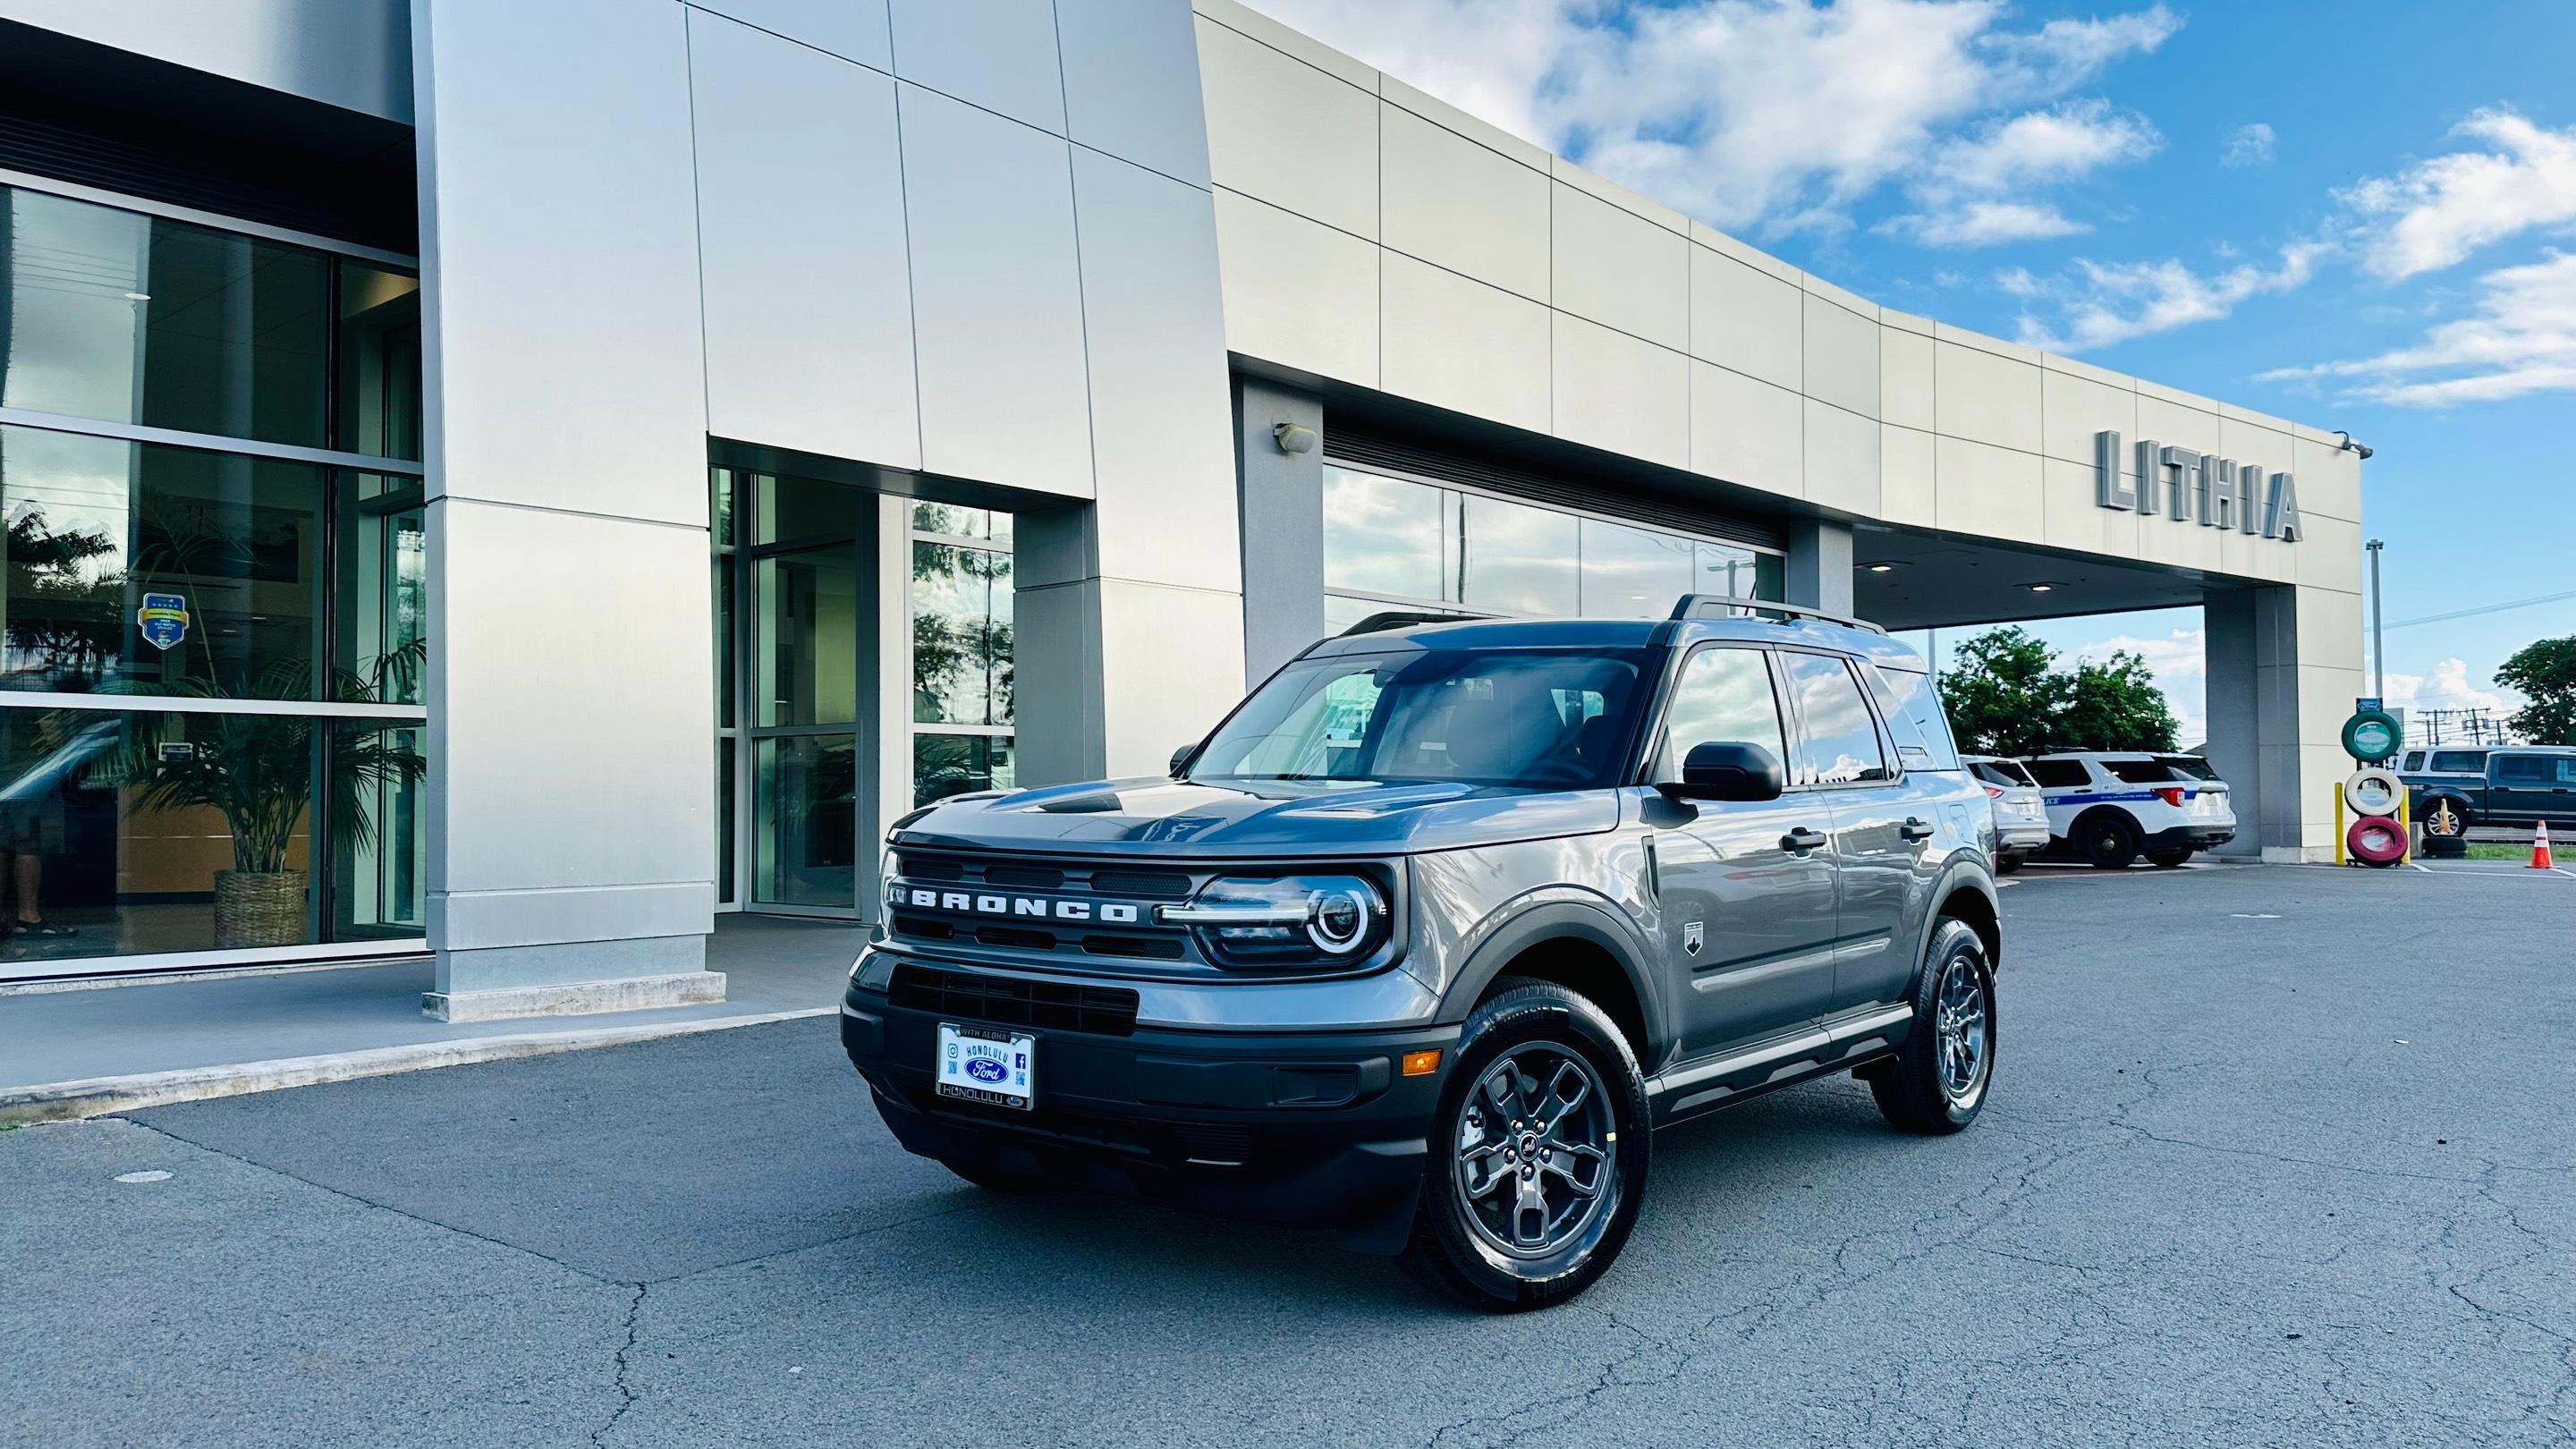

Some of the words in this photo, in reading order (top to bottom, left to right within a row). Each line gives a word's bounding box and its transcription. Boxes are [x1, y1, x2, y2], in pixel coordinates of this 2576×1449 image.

[2096, 430, 2303, 542] LITHIA
[911, 889, 1138, 922] BRONCO
[961, 1027, 980, 1038] WITH
[966, 1045, 1008, 1063] HONOLULU
[972, 1060, 1000, 1080] Ford
[943, 1084, 1003, 1104] HONOLULU
